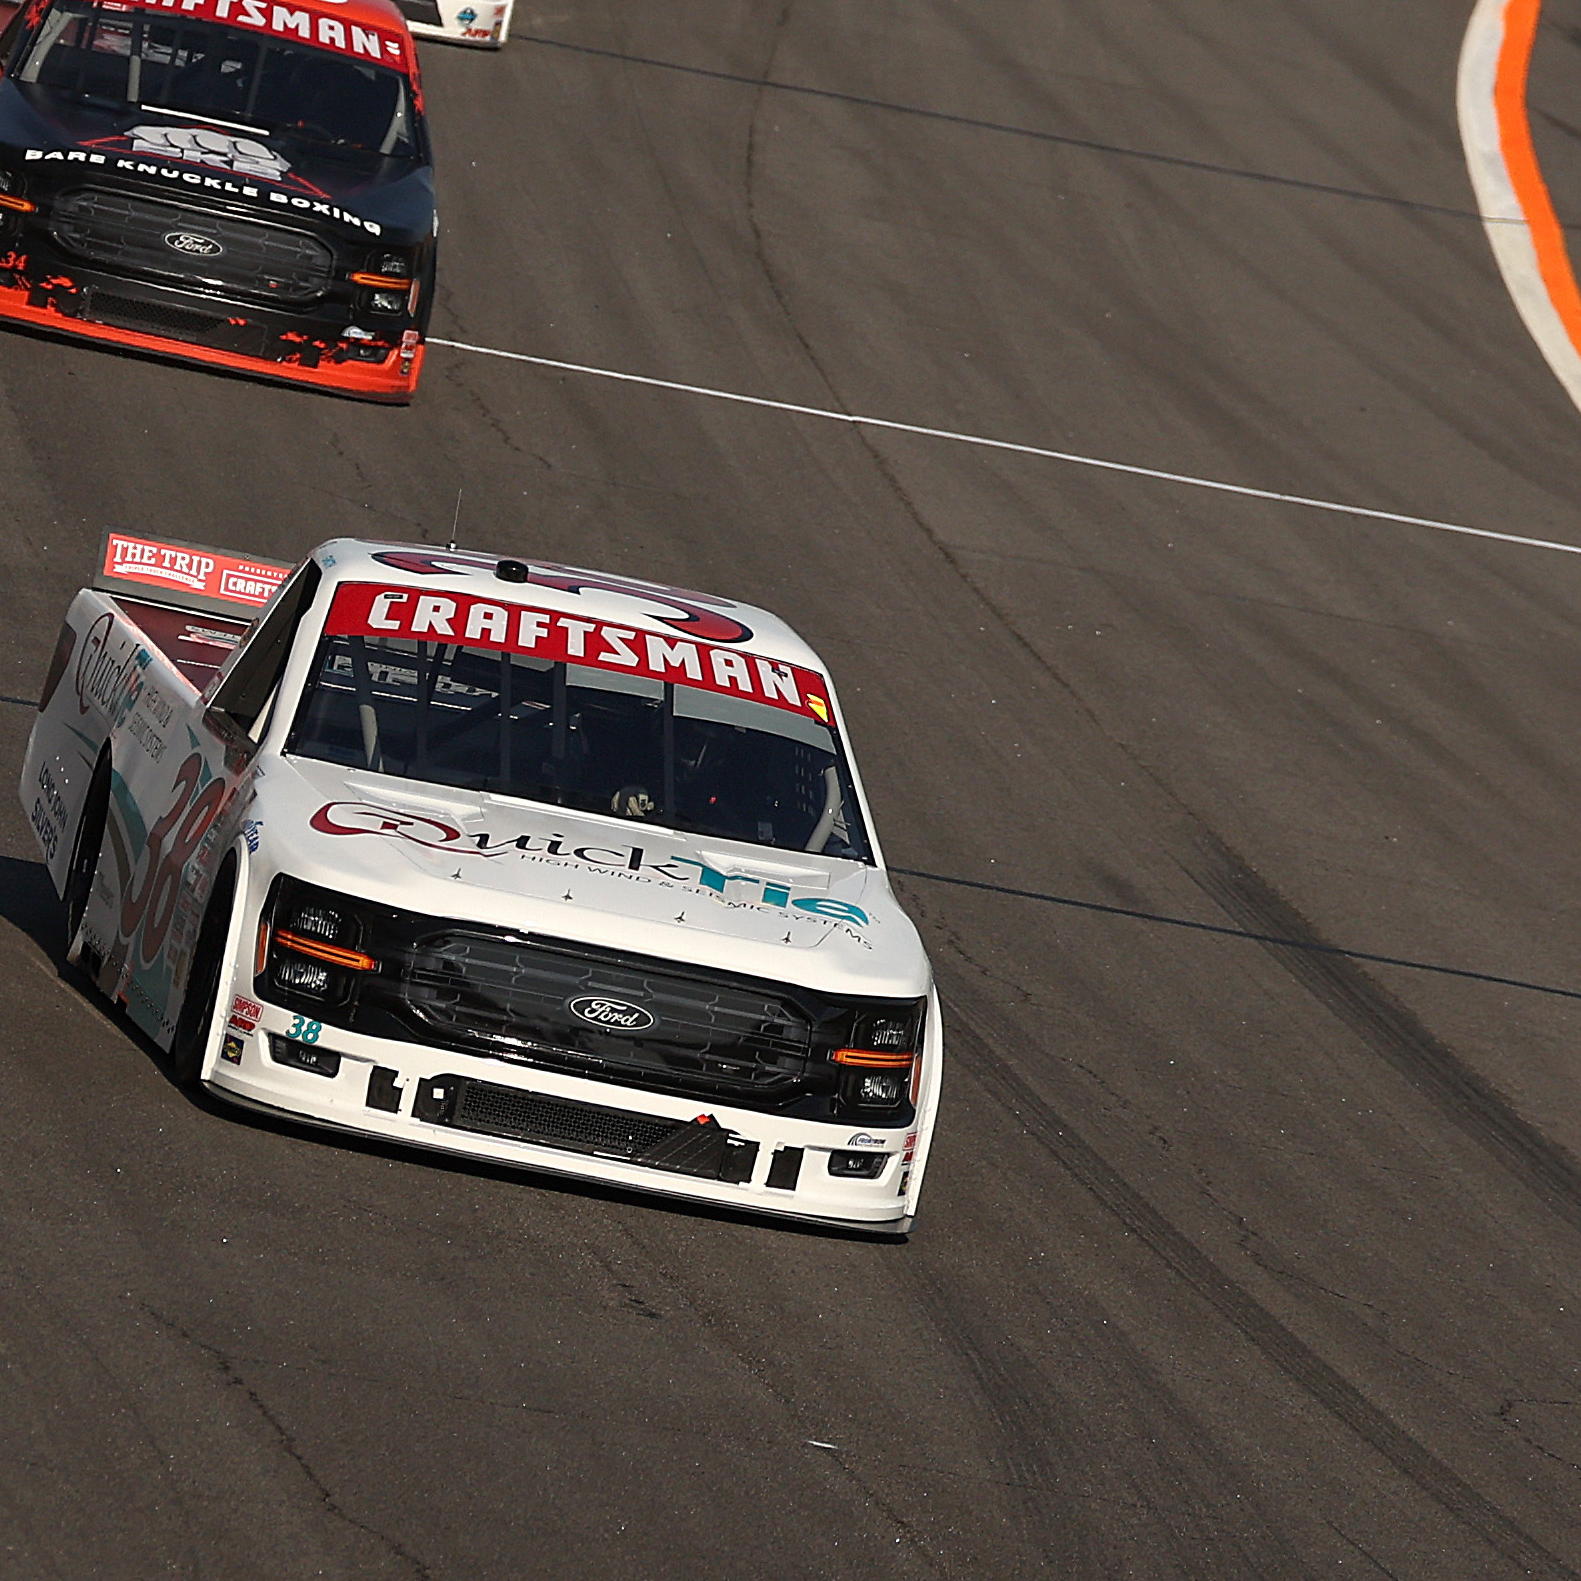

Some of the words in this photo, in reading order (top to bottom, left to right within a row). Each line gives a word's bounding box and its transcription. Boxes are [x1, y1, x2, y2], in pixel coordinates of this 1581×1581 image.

[24, 149, 107, 165] BARE
[116, 159, 259, 198] KNUCKLE
[269, 191, 382, 236] BOXING
[4, 250, 28, 270] 34
[173, 233, 214, 254] Ford
[112, 538, 158, 565] THE
[159, 548, 216, 581] TRIP
[367, 592, 802, 708] CRAFTSMAN
[120, 751, 226, 970] 38
[520, 853, 581, 871] HIGH
[587, 865, 653, 885] WIND
[680, 885, 773, 914] SEISMIC
[779, 910, 874, 951] SYSTEMS
[286, 1014, 323, 1045] 38
[583, 999, 640, 1027] Ford
